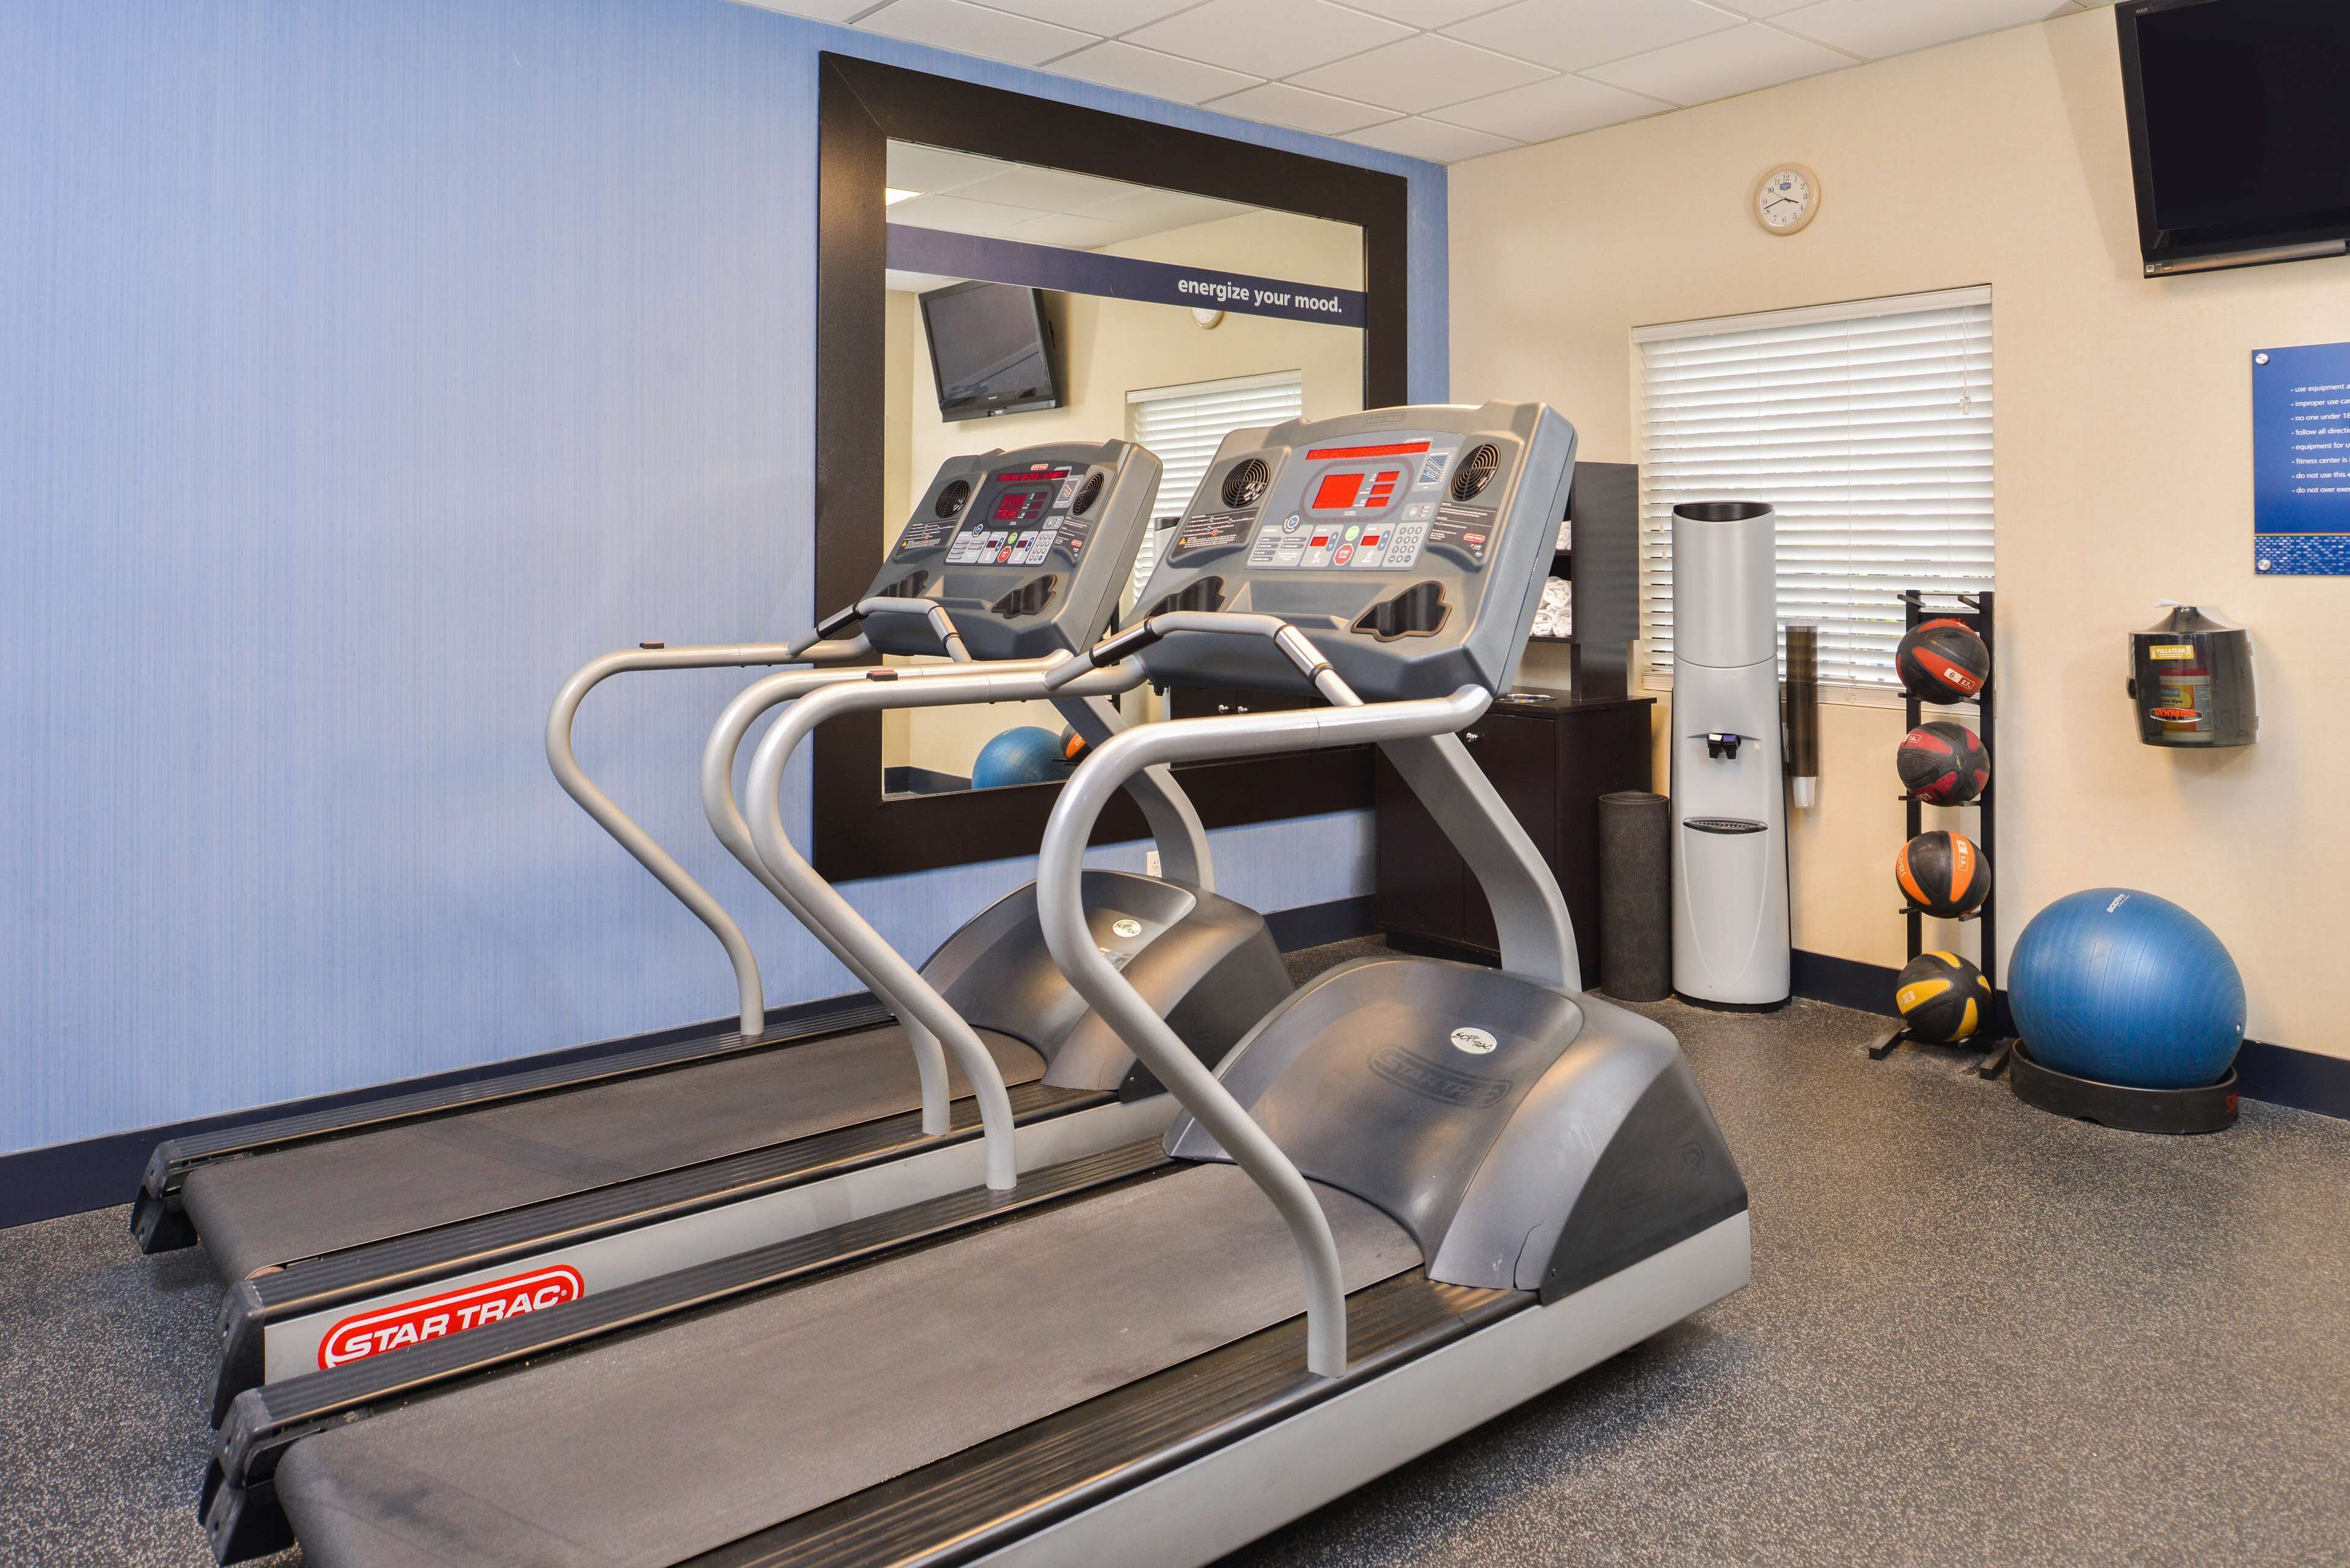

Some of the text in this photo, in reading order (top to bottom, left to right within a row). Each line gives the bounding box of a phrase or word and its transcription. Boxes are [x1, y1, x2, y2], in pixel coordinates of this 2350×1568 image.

[1178, 280, 1342, 313] energize your mood.
[2106, 894, 2127, 913] BODYFIT
[345, 1313, 450, 1353] STAR
